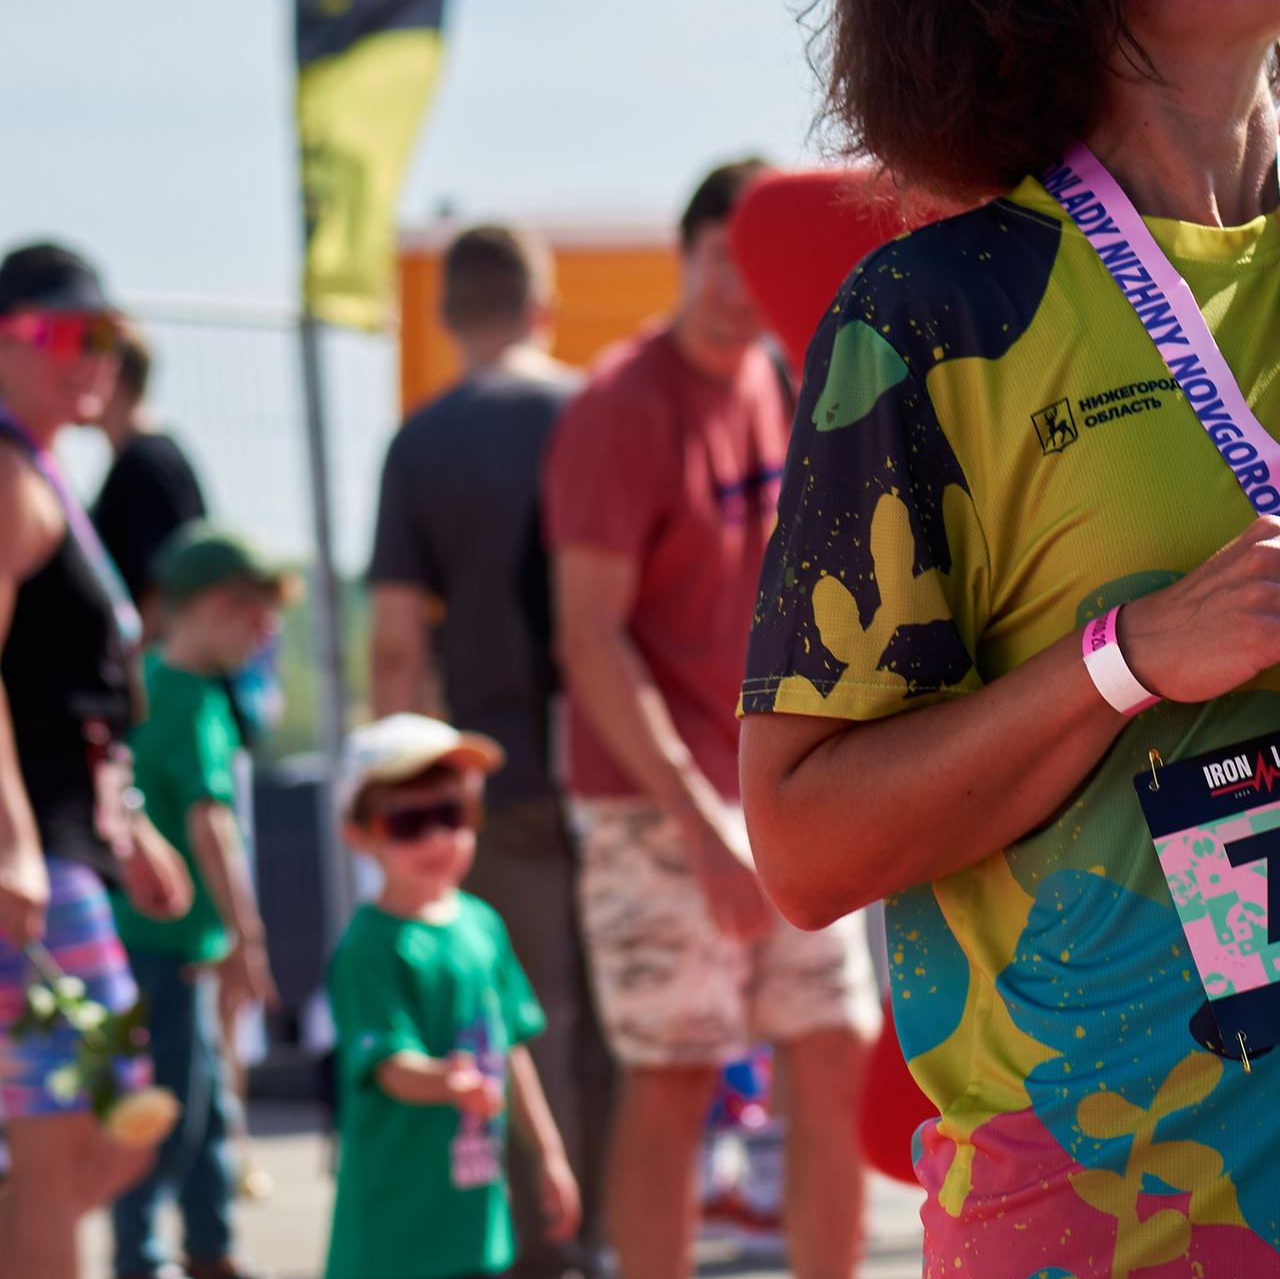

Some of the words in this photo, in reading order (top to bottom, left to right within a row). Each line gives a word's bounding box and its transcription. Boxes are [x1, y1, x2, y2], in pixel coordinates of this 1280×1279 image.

[1096, 240, 1190, 346] NIZHNY
[1085, 397, 1162, 428] ОБЛАСТЬ
[1202, 753, 1253, 789] IRON
